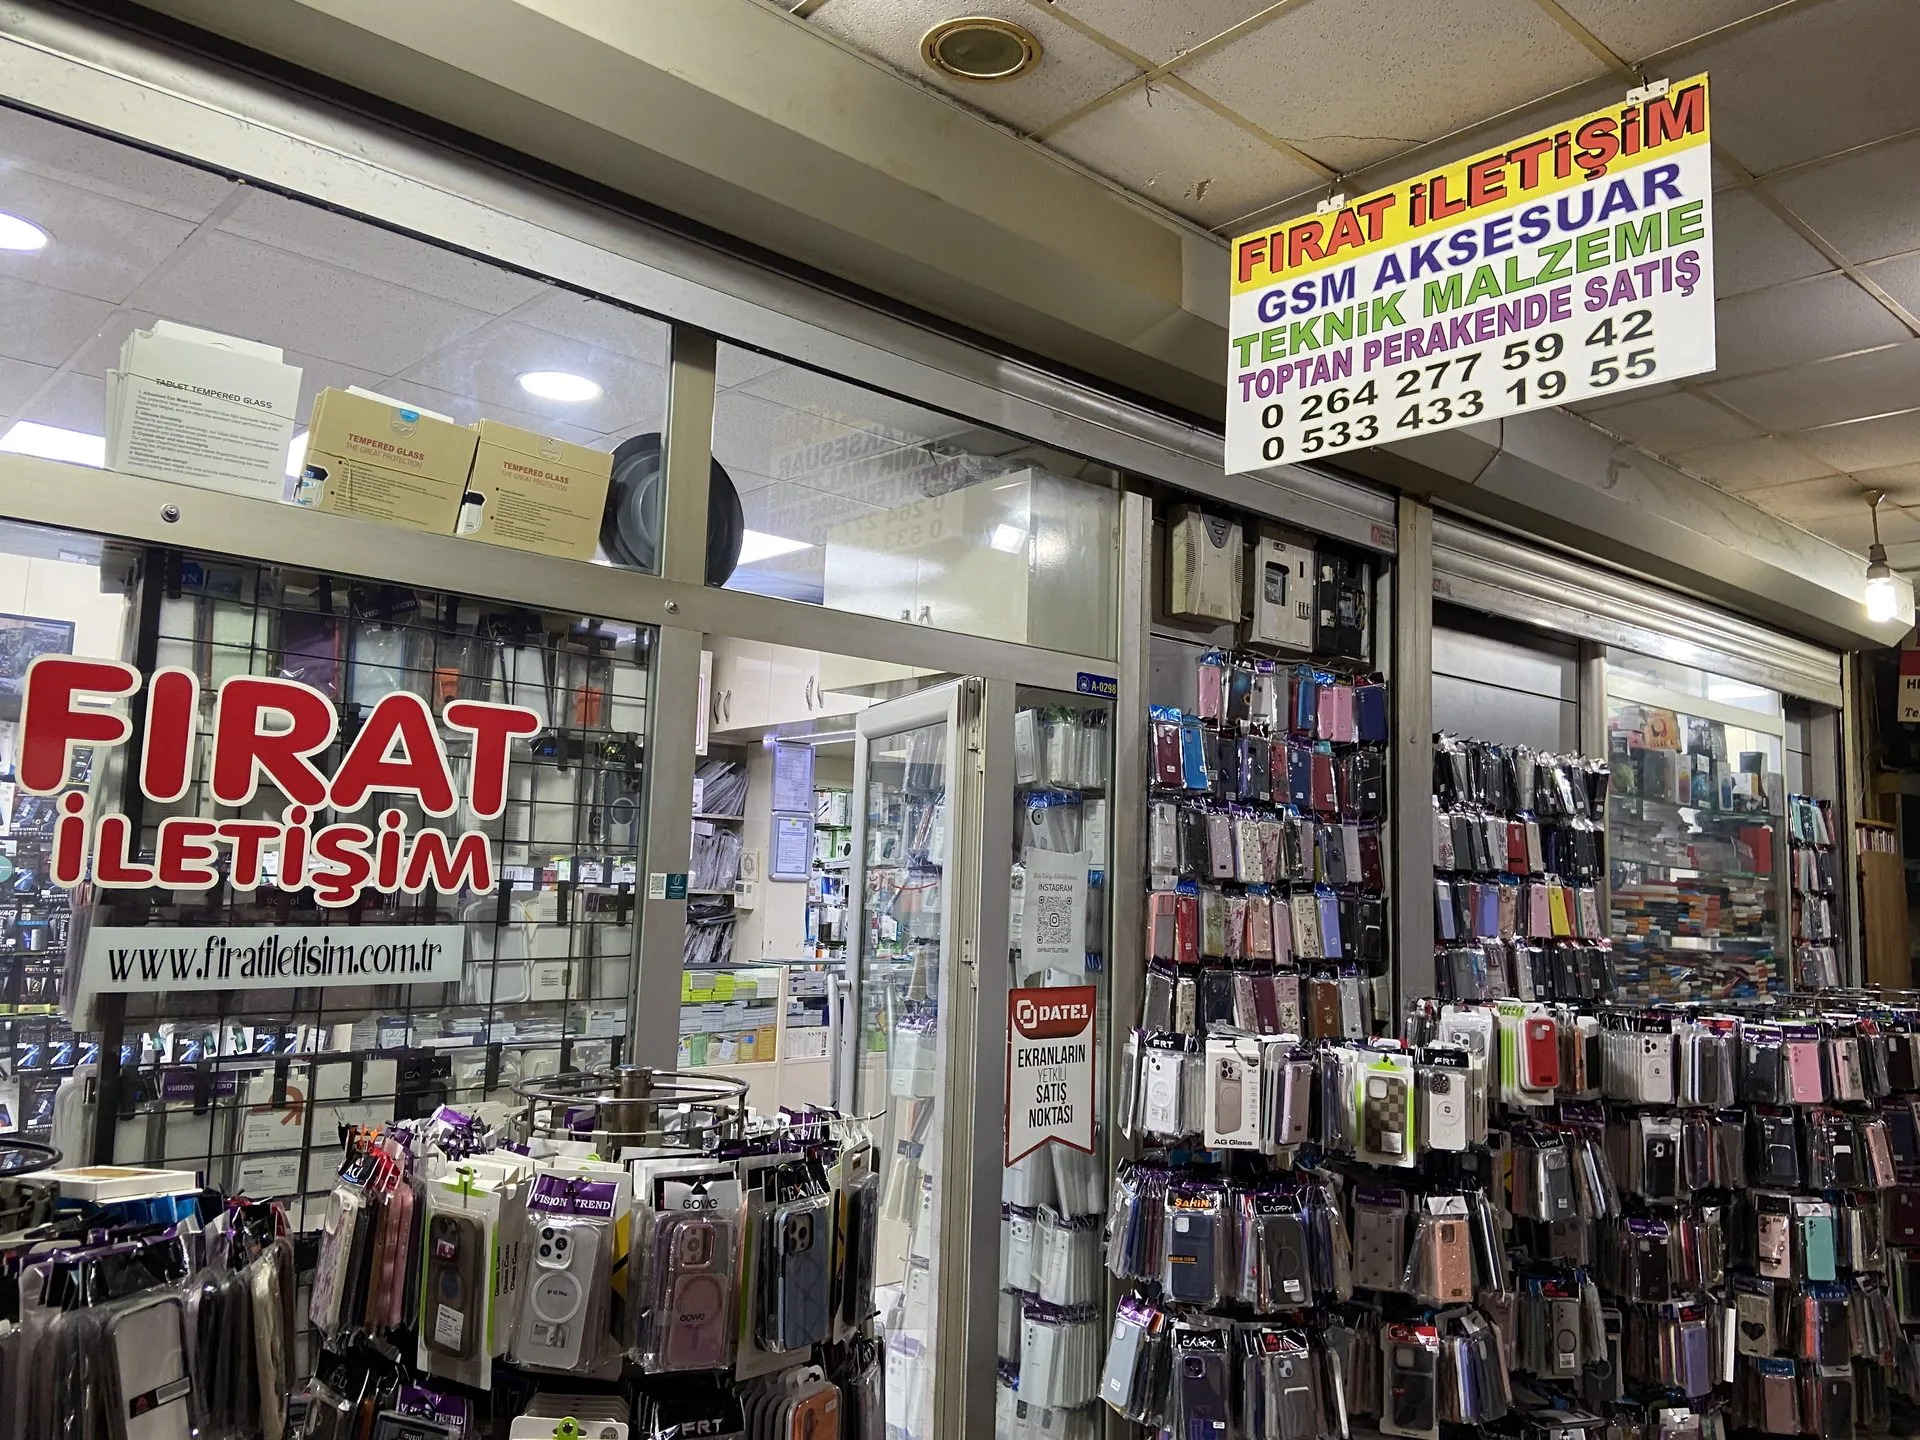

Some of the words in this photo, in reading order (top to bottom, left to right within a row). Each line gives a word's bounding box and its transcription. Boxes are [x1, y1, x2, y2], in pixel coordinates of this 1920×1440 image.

[1239, 194, 1396, 283] FIRAT
[1257, 266, 1356, 323] GSM
[1373, 163, 1682, 290] AKSESUAR
[1423, 200, 1705, 318] MALZEME
[1239, 346, 1352, 403] TOPTAN
[1363, 285, 1572, 372] PERAKENDE
[1584, 250, 1702, 312] SATIŞ
[1262, 404, 1284, 429] 0
[1300, 379, 1378, 422] 264
[1396, 353, 1482, 397] 277
[1502, 332, 1564, 372] 59
[1585, 309, 1654, 347] 42
[155, 378, 189, 391] TABLET
[191, 385, 240, 402] TEMPERED
[243, 397, 273, 409] GLASS
[1262, 436, 1285, 462] 0
[1301, 415, 1379, 455] 533
[1396, 390, 1484, 430] 433
[1507, 370, 1567, 406] 19
[1589, 348, 1657, 388] 55
[346, 442, 359, 452] THE
[348, 433, 395, 452] TEMPERED
[396, 447, 425, 461] GLASS
[503, 461, 543, 478] TEMPERED
[545, 472, 569, 484] GLASS
[17, 655, 541, 819] FIRAT
[1038, 883, 1073, 892] INSTAGRAM
[108, 935, 442, 982] www.firatiletisim.com.tr
[1018, 1044, 1086, 1068] EKRANLARIN
[1153, 1040, 1174, 1049] FRT
[1434, 1056, 1457, 1066] FRT
[1036, 1082, 1067, 1104] SATIŞ
[1029, 1105, 1073, 1129] NOKTASI
[1213, 1138, 1229, 1146] AG
[534, 1192, 568, 1208] VISION
[573, 1198, 611, 1210] TREND
[781, 1180, 824, 1203] TEXMA
[1263, 1204, 1293, 1214] CAPPY
[681, 1418, 723, 1437] FRT
